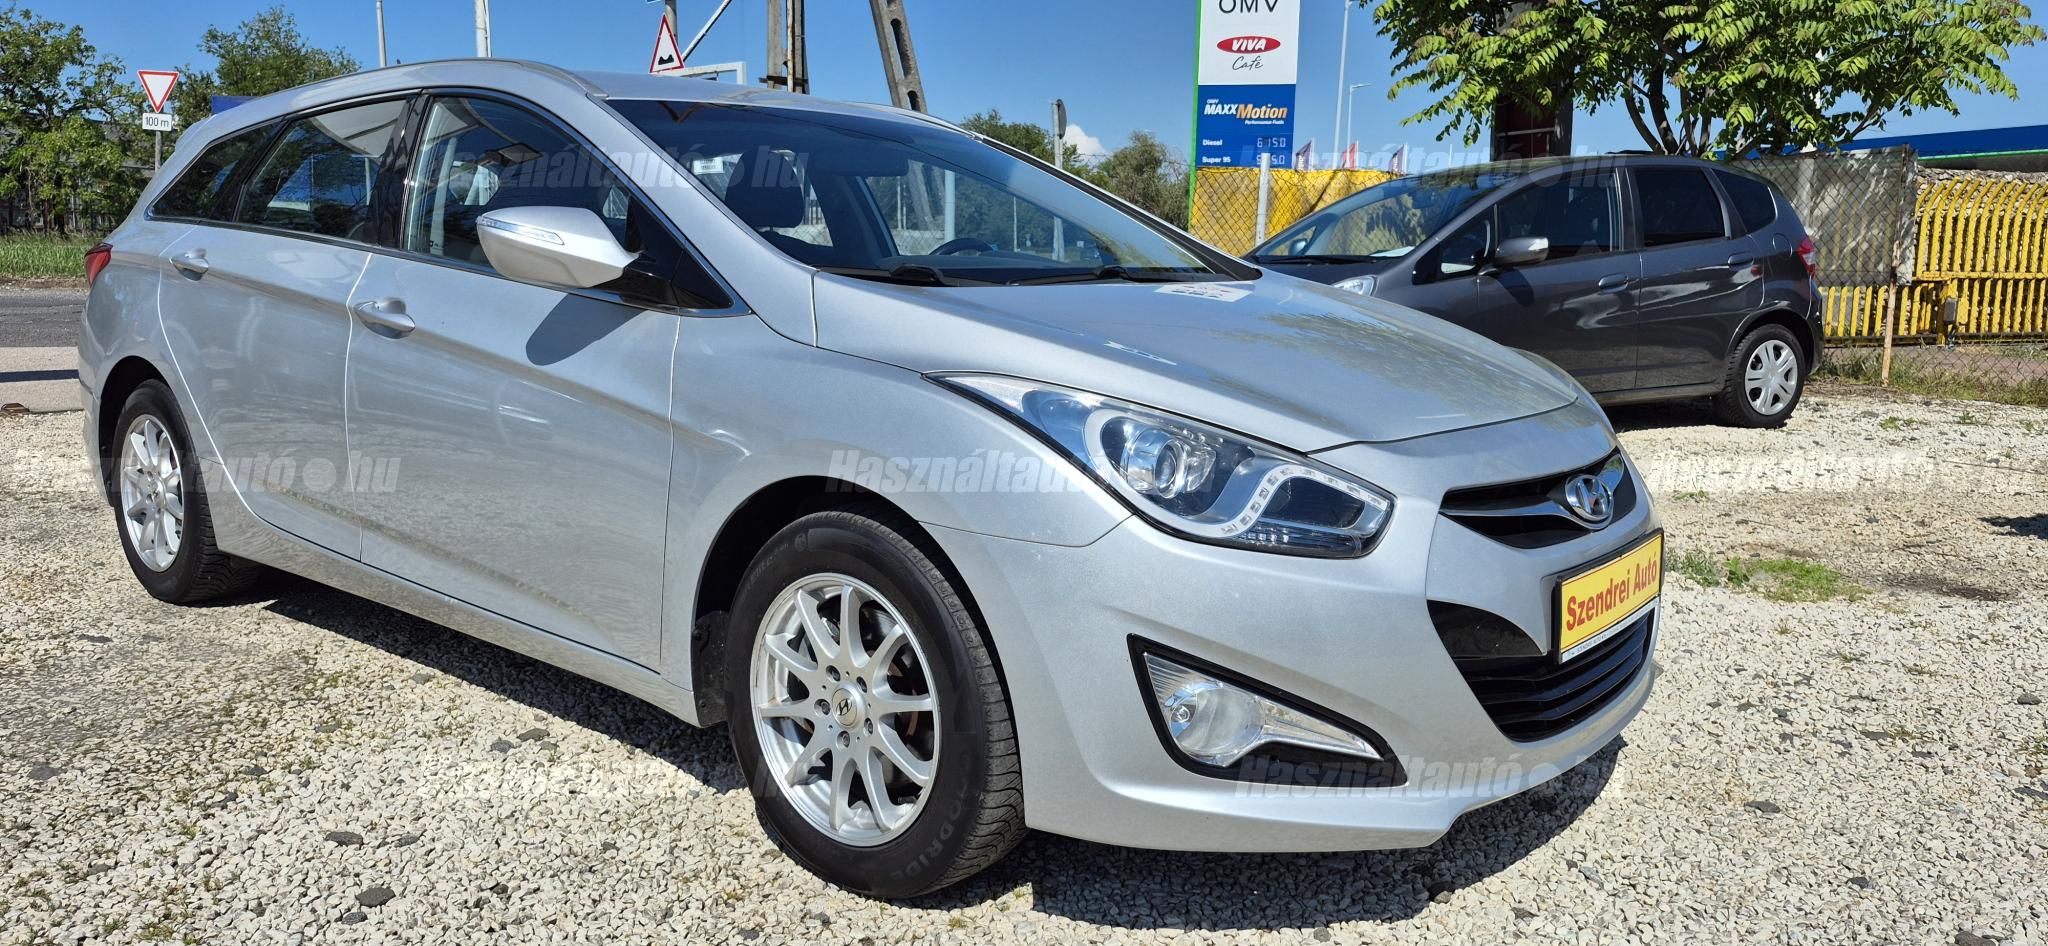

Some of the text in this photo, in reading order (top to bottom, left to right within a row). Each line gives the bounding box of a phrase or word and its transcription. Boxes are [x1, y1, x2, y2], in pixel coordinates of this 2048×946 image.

[1219, 0, 1278, 13] OMV
[1232, 38, 1267, 51] VIVA
[1232, 55, 1263, 70] Café
[145, 116, 158, 127] 100
[1202, 156, 1222, 164] Super
[1566, 568, 1631, 631] Szendrei
[1633, 551, 1658, 596] Autó
